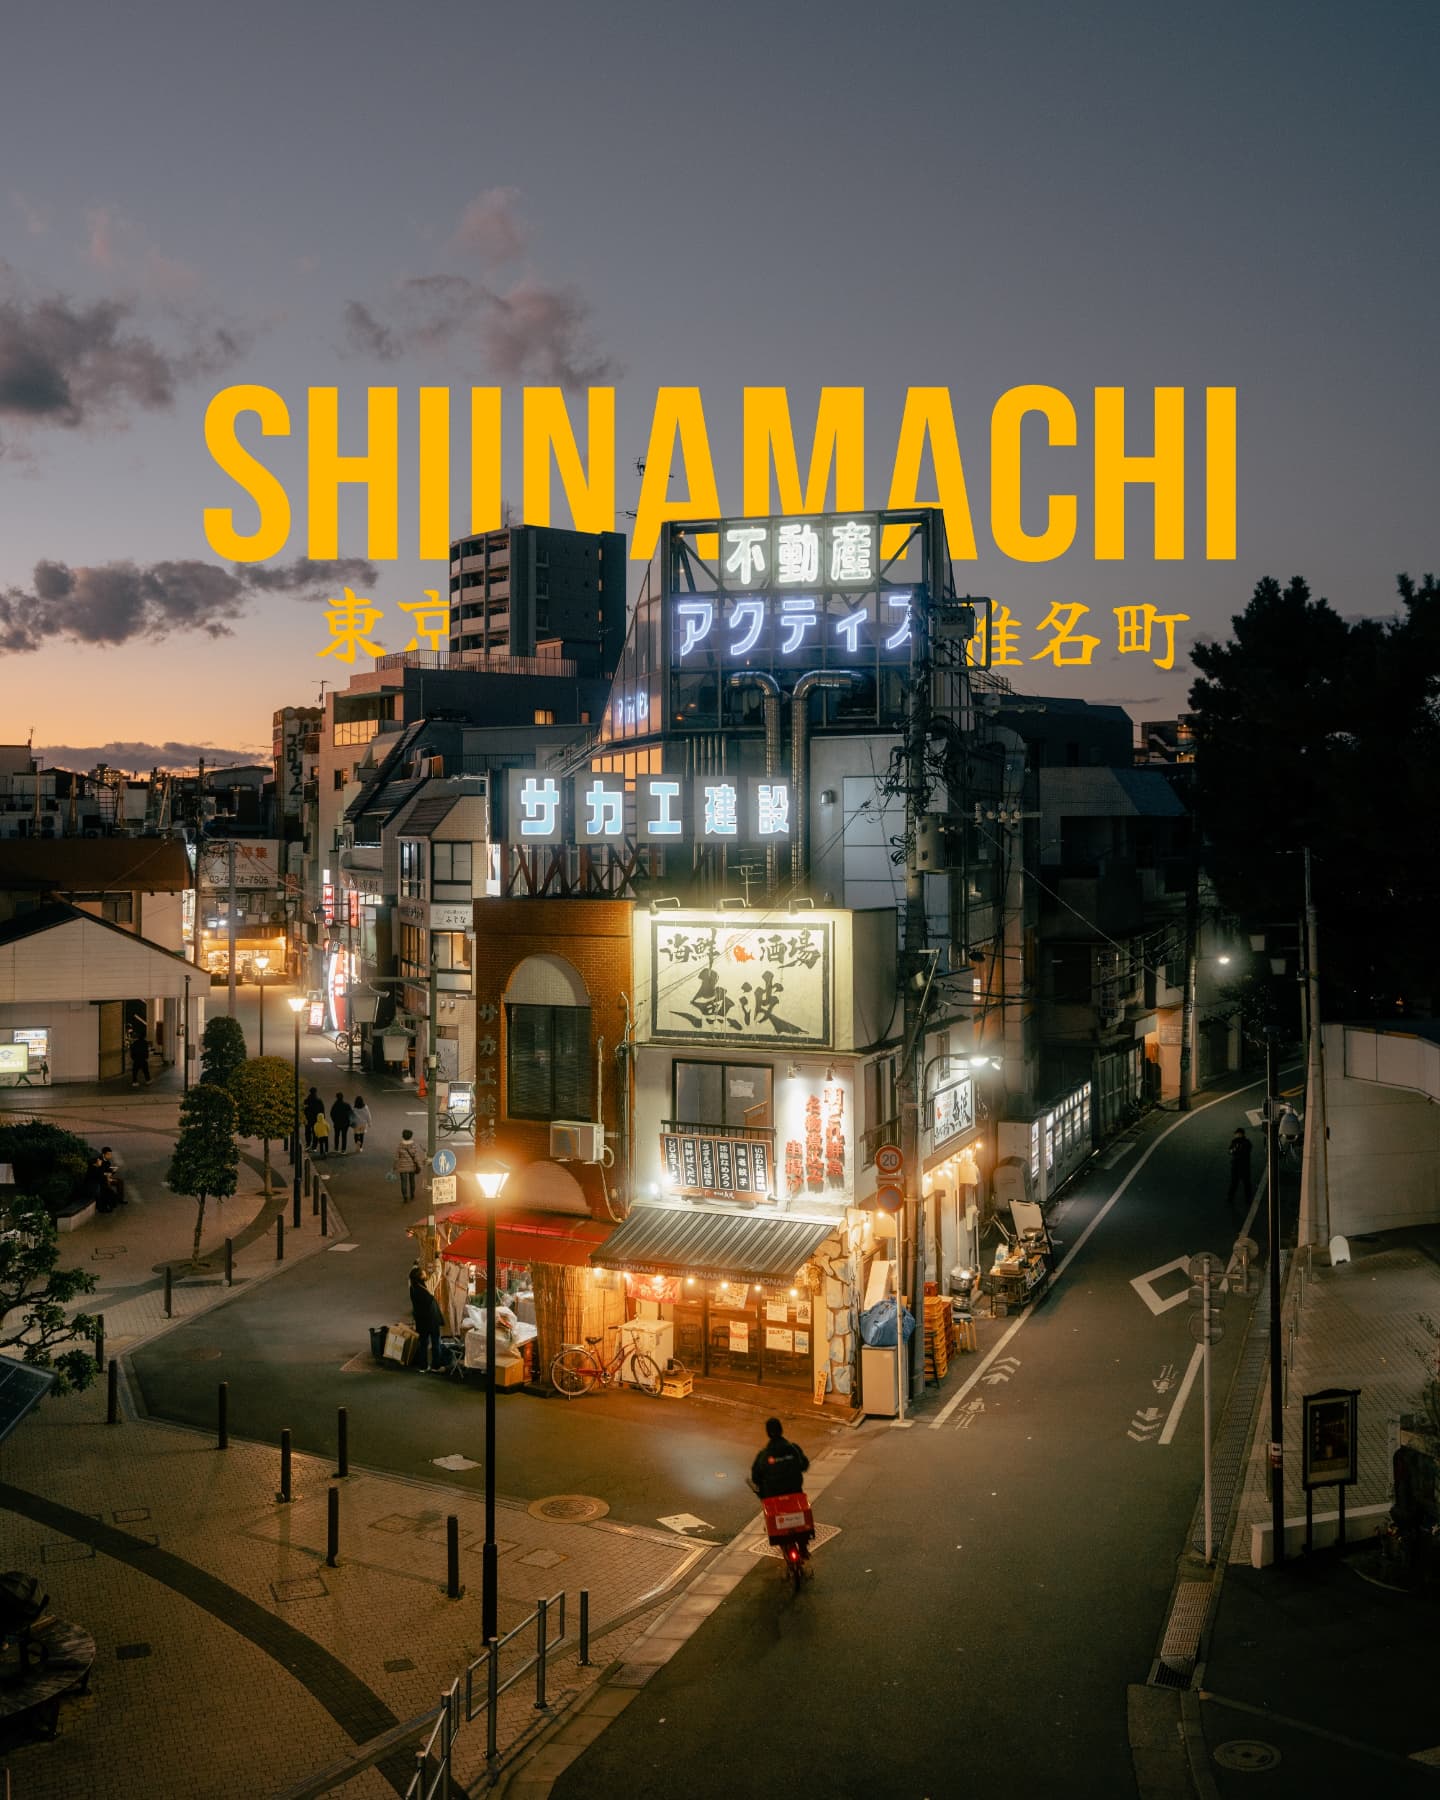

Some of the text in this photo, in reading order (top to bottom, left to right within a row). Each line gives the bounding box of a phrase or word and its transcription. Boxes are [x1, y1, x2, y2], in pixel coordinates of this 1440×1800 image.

[725, 523, 872, 585] 不動産
[520, 778, 790, 835] サカエ建設
[659, 926, 822, 969] 海鮮 酒場
[669, 967, 810, 1035] 魚波
[882, 1153, 898, 1167] 20
